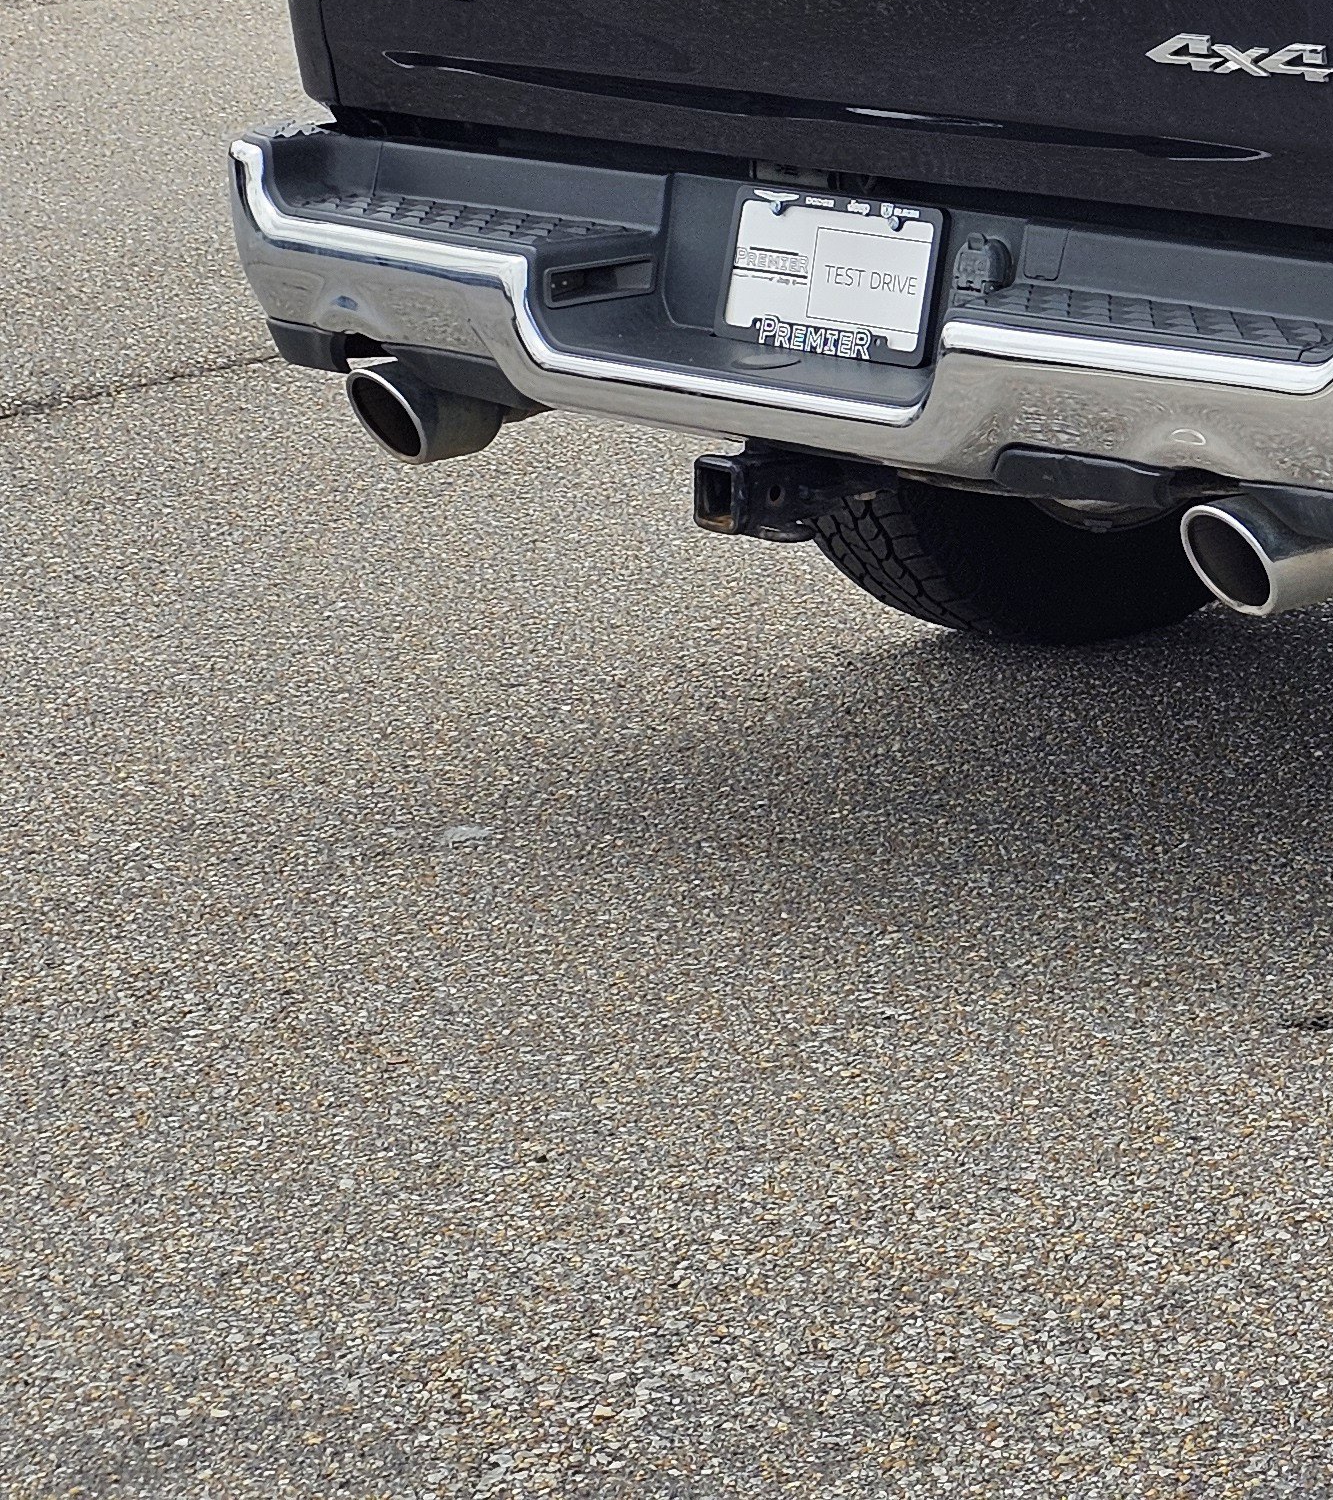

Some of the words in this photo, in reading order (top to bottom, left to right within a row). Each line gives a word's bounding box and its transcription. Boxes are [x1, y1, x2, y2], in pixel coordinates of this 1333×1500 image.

[734, 246, 809, 274] PREMIER
[824, 264, 866, 287] TEST
[869, 271, 918, 295] DRIVE
[757, 314, 871, 360] PREMIER
